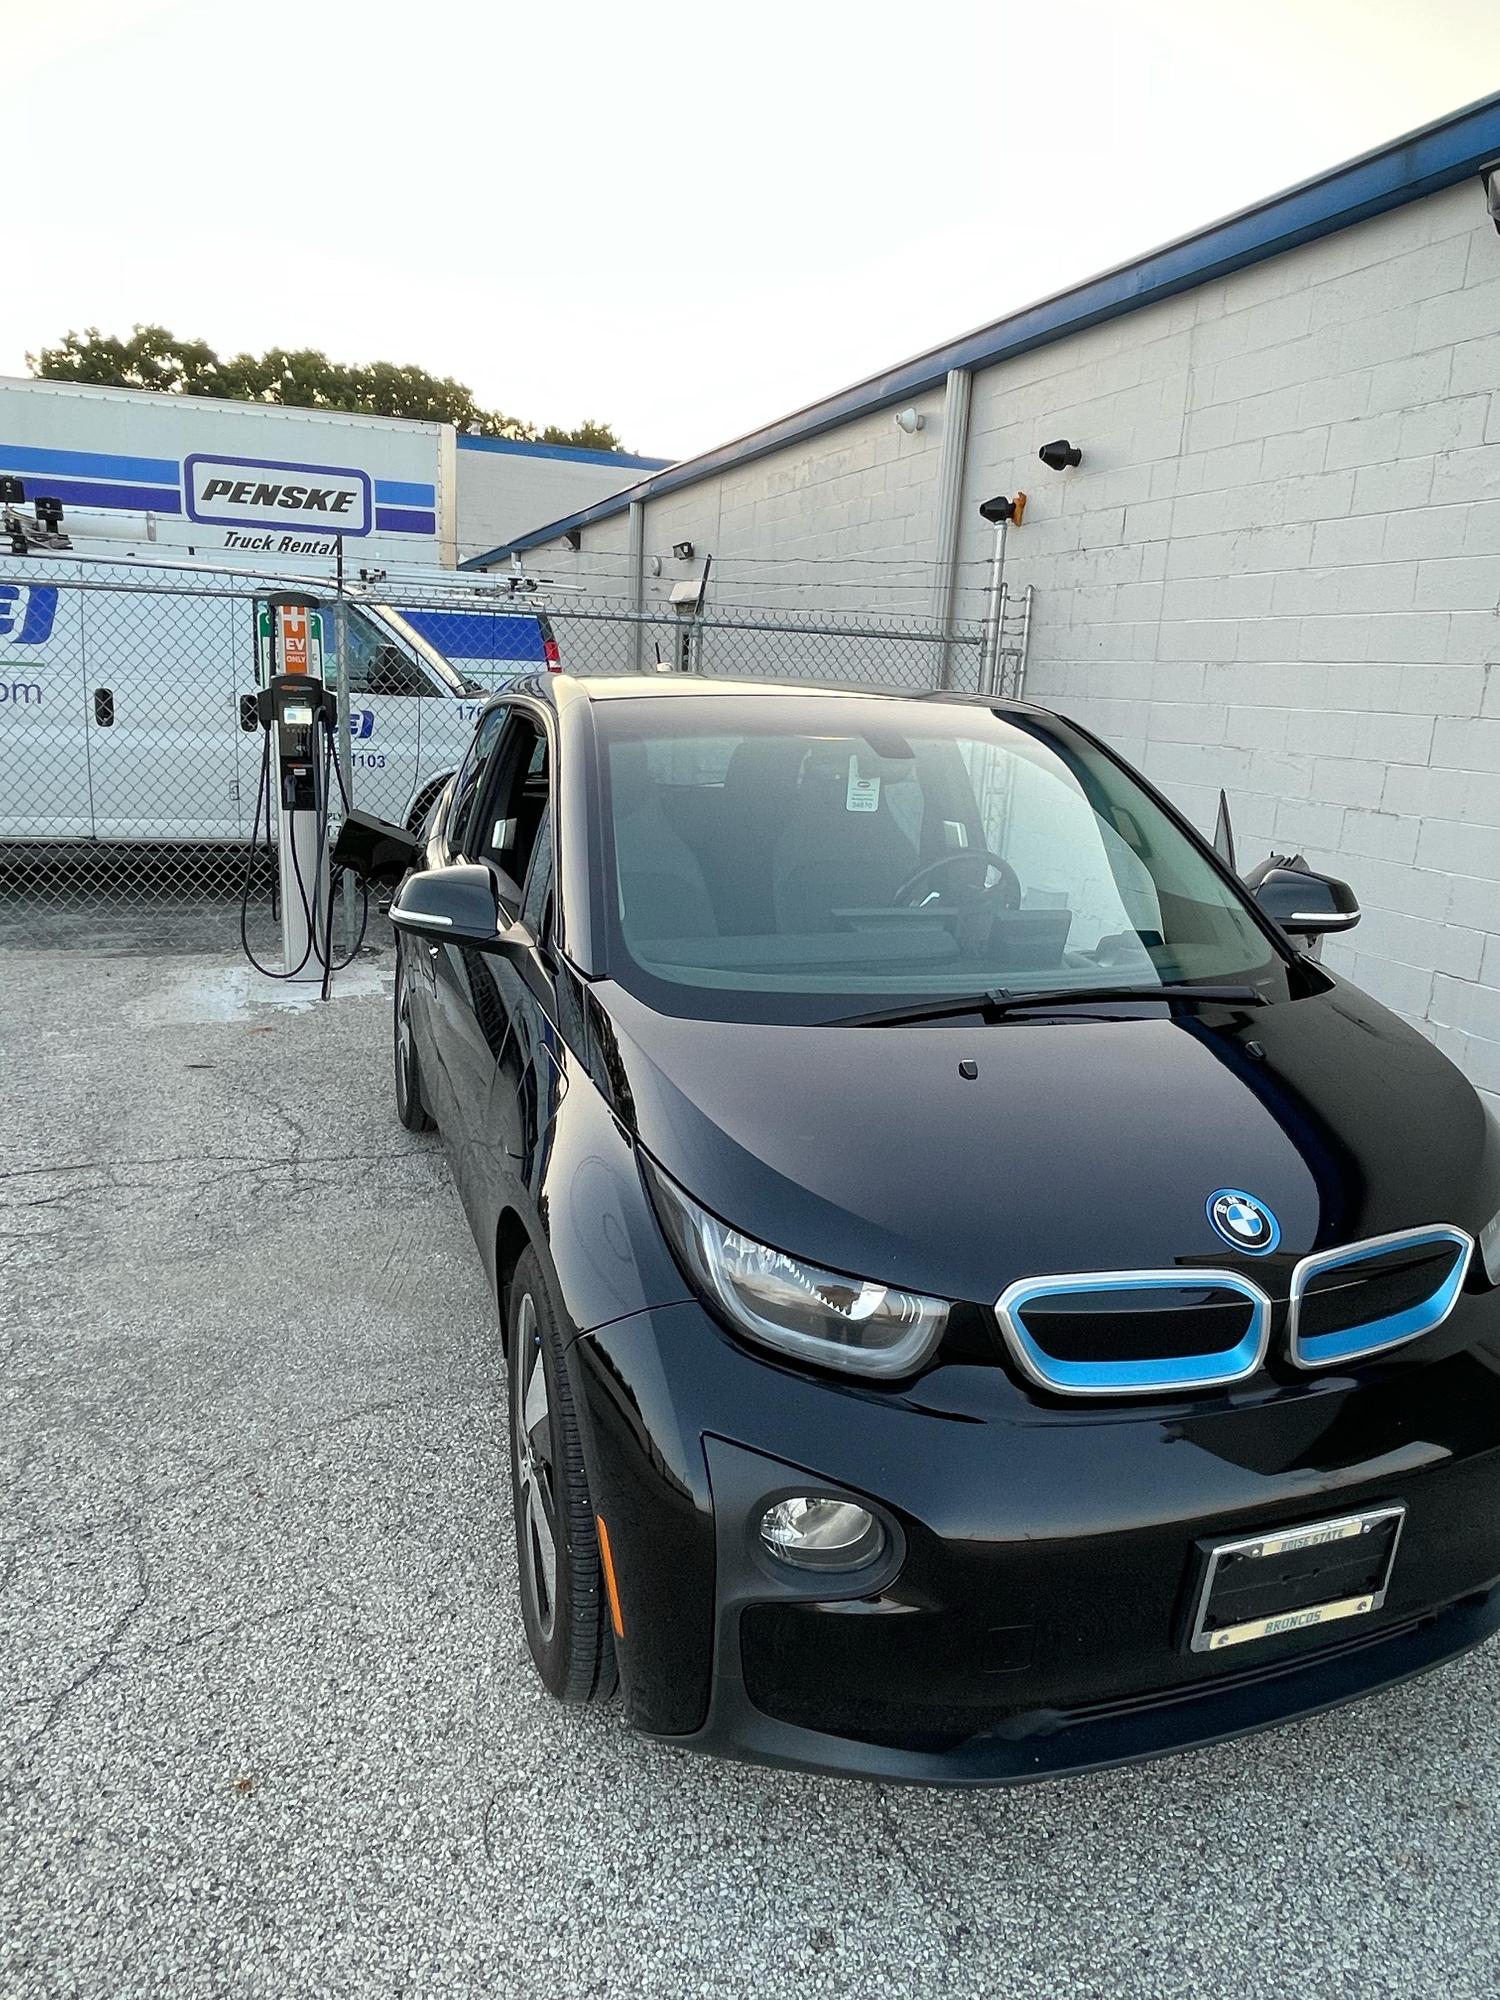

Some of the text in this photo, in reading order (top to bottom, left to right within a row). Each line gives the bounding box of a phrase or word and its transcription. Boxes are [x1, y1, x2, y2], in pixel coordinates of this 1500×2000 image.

[201, 479, 357, 513] PENSKE
[223, 531, 339, 555] Truck Rental
[285, 637, 305, 651] EV
[286, 655, 306, 663] ONLY
[1217, 1196, 1258, 1214] BMW
[1281, 1528, 1345, 1551] BOISE STATE
[1264, 1610, 1322, 1633] BRONCOS
